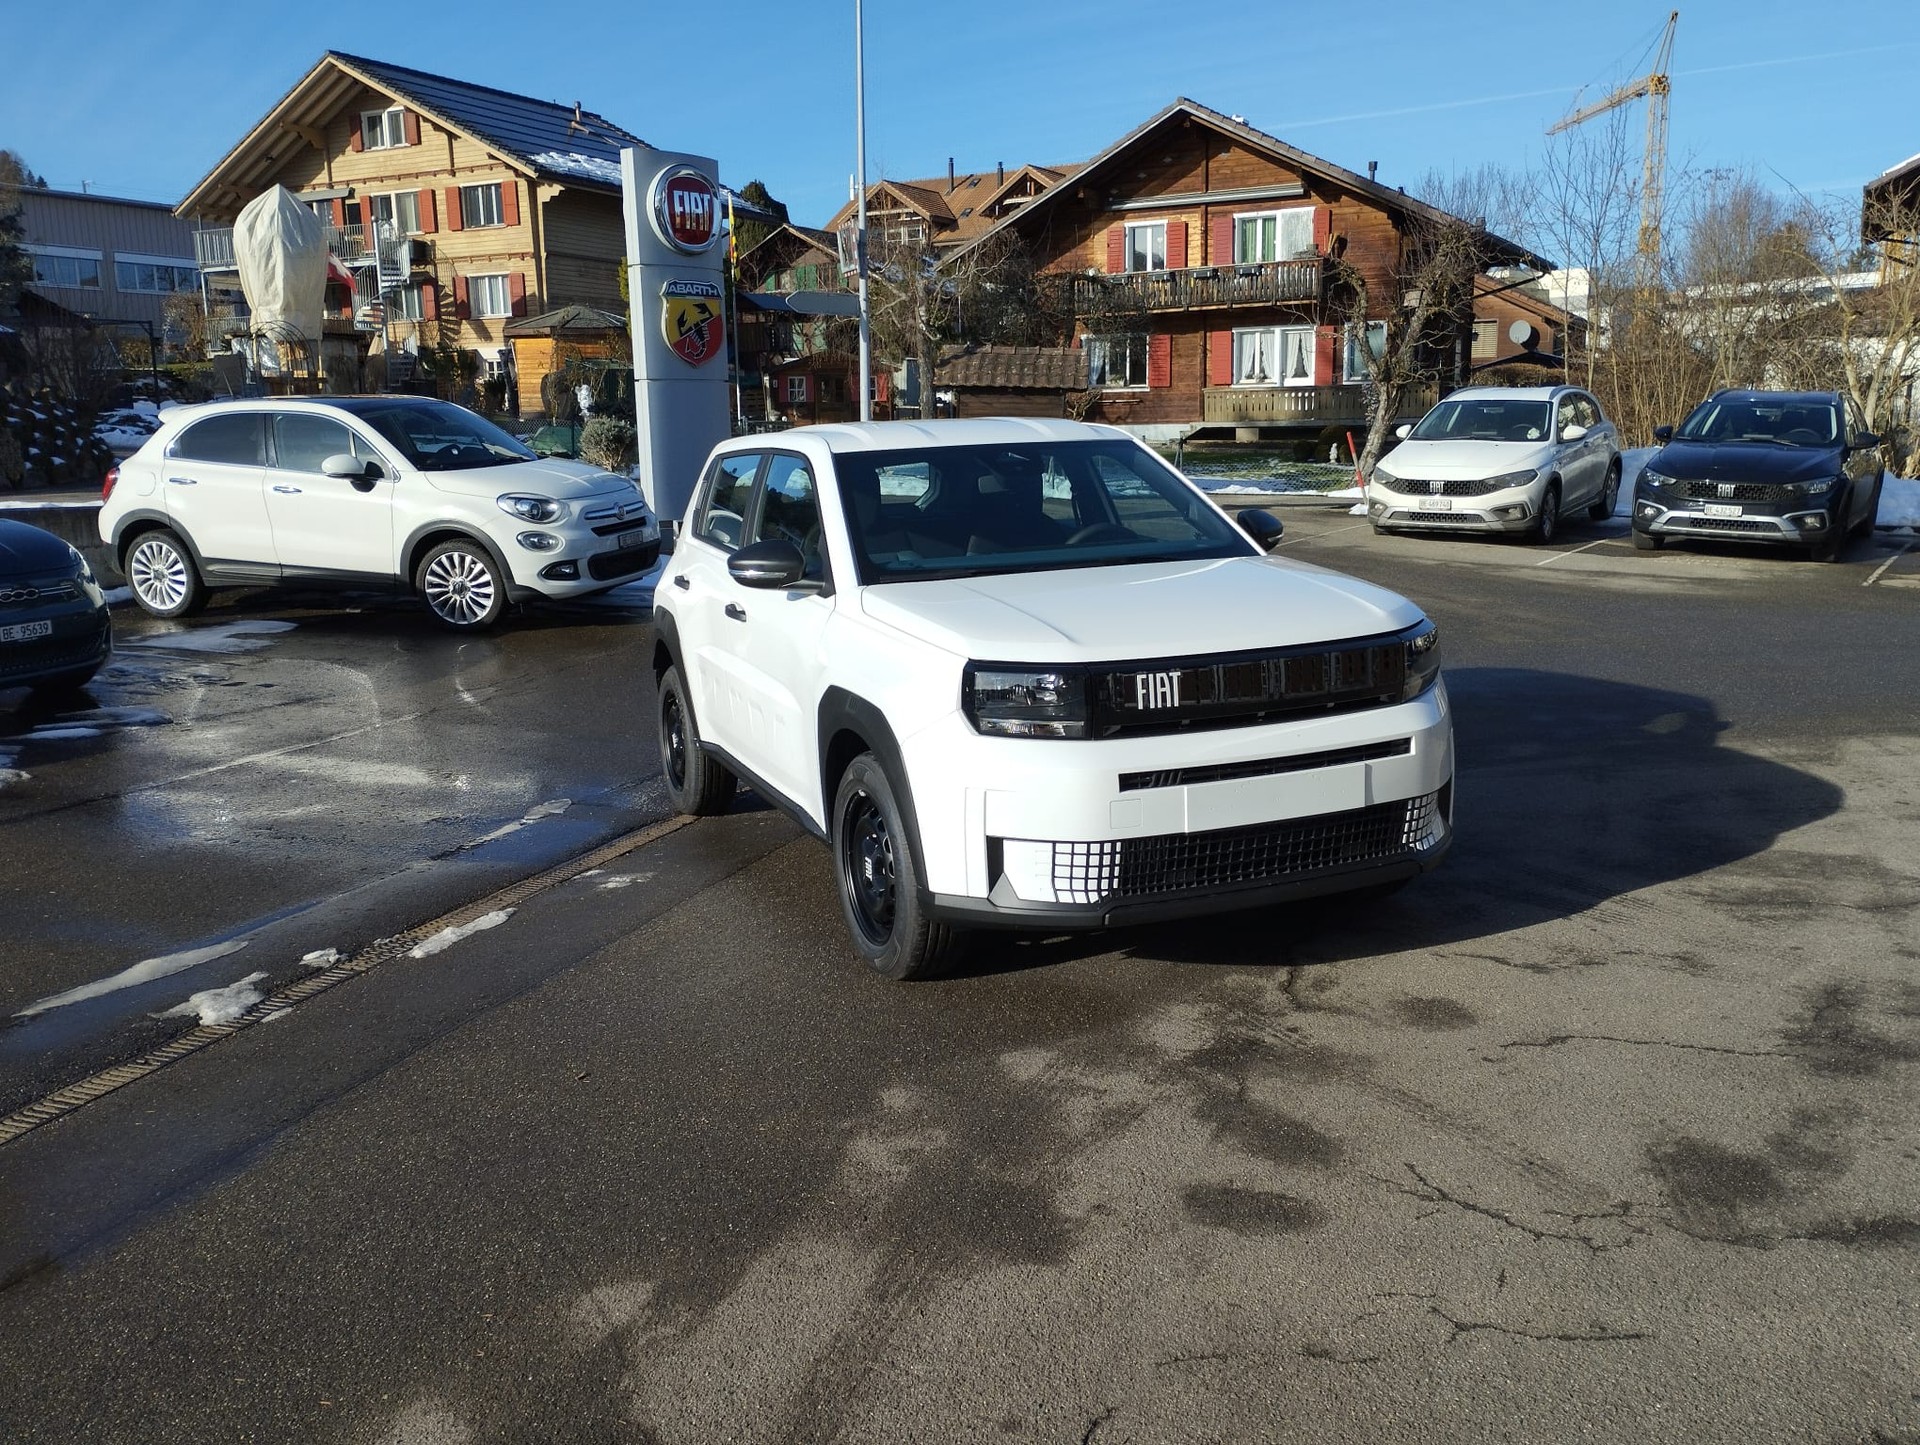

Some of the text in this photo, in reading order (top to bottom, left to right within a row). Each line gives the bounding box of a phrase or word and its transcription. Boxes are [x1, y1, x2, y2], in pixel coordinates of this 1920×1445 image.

[673, 189, 711, 231] FIAT
[668, 284, 718, 296] ABARTH
[1429, 481, 1445, 493] FIAT
[1718, 484, 1735, 497] FIAT
[1136, 671, 1182, 710] FIAT
